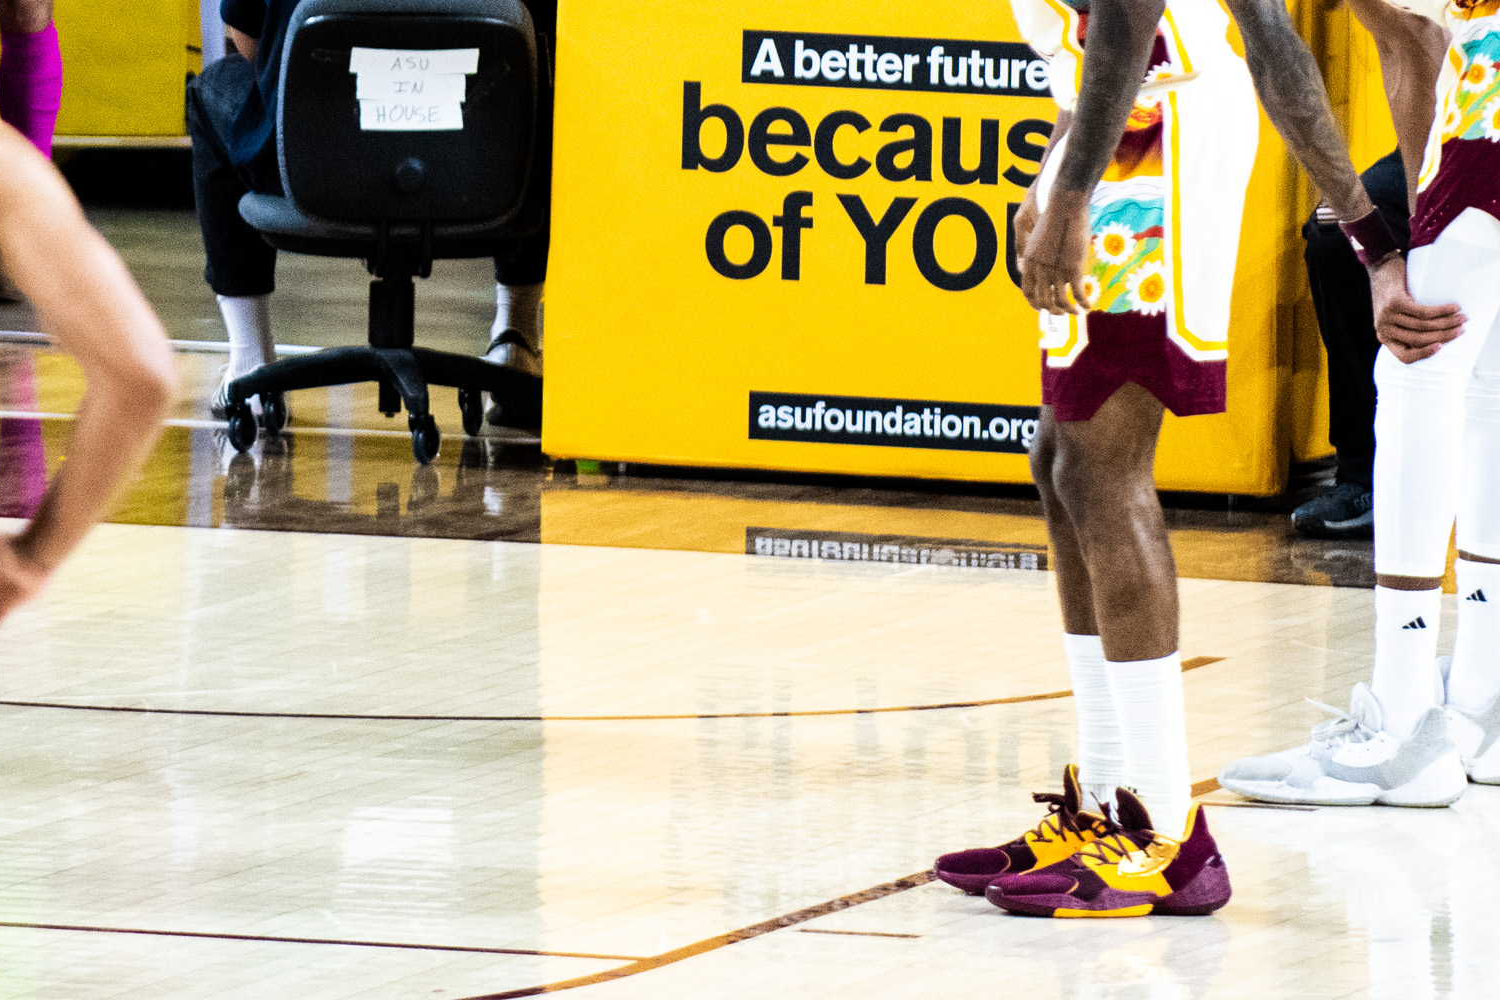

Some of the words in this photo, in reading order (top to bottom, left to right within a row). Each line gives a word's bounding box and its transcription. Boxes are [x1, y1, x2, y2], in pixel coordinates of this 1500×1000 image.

[390, 56, 430, 71] ASU
[750, 37, 785, 78] A
[793, 39, 920, 83] better
[926, 46, 1051, 91] future
[392, 81, 424, 94] IN
[375, 103, 441, 123] HOUSE
[681, 80, 1056, 189] becaus
[704, 190, 814, 281] of
[757, 401, 1041, 448] asufoundation.org
